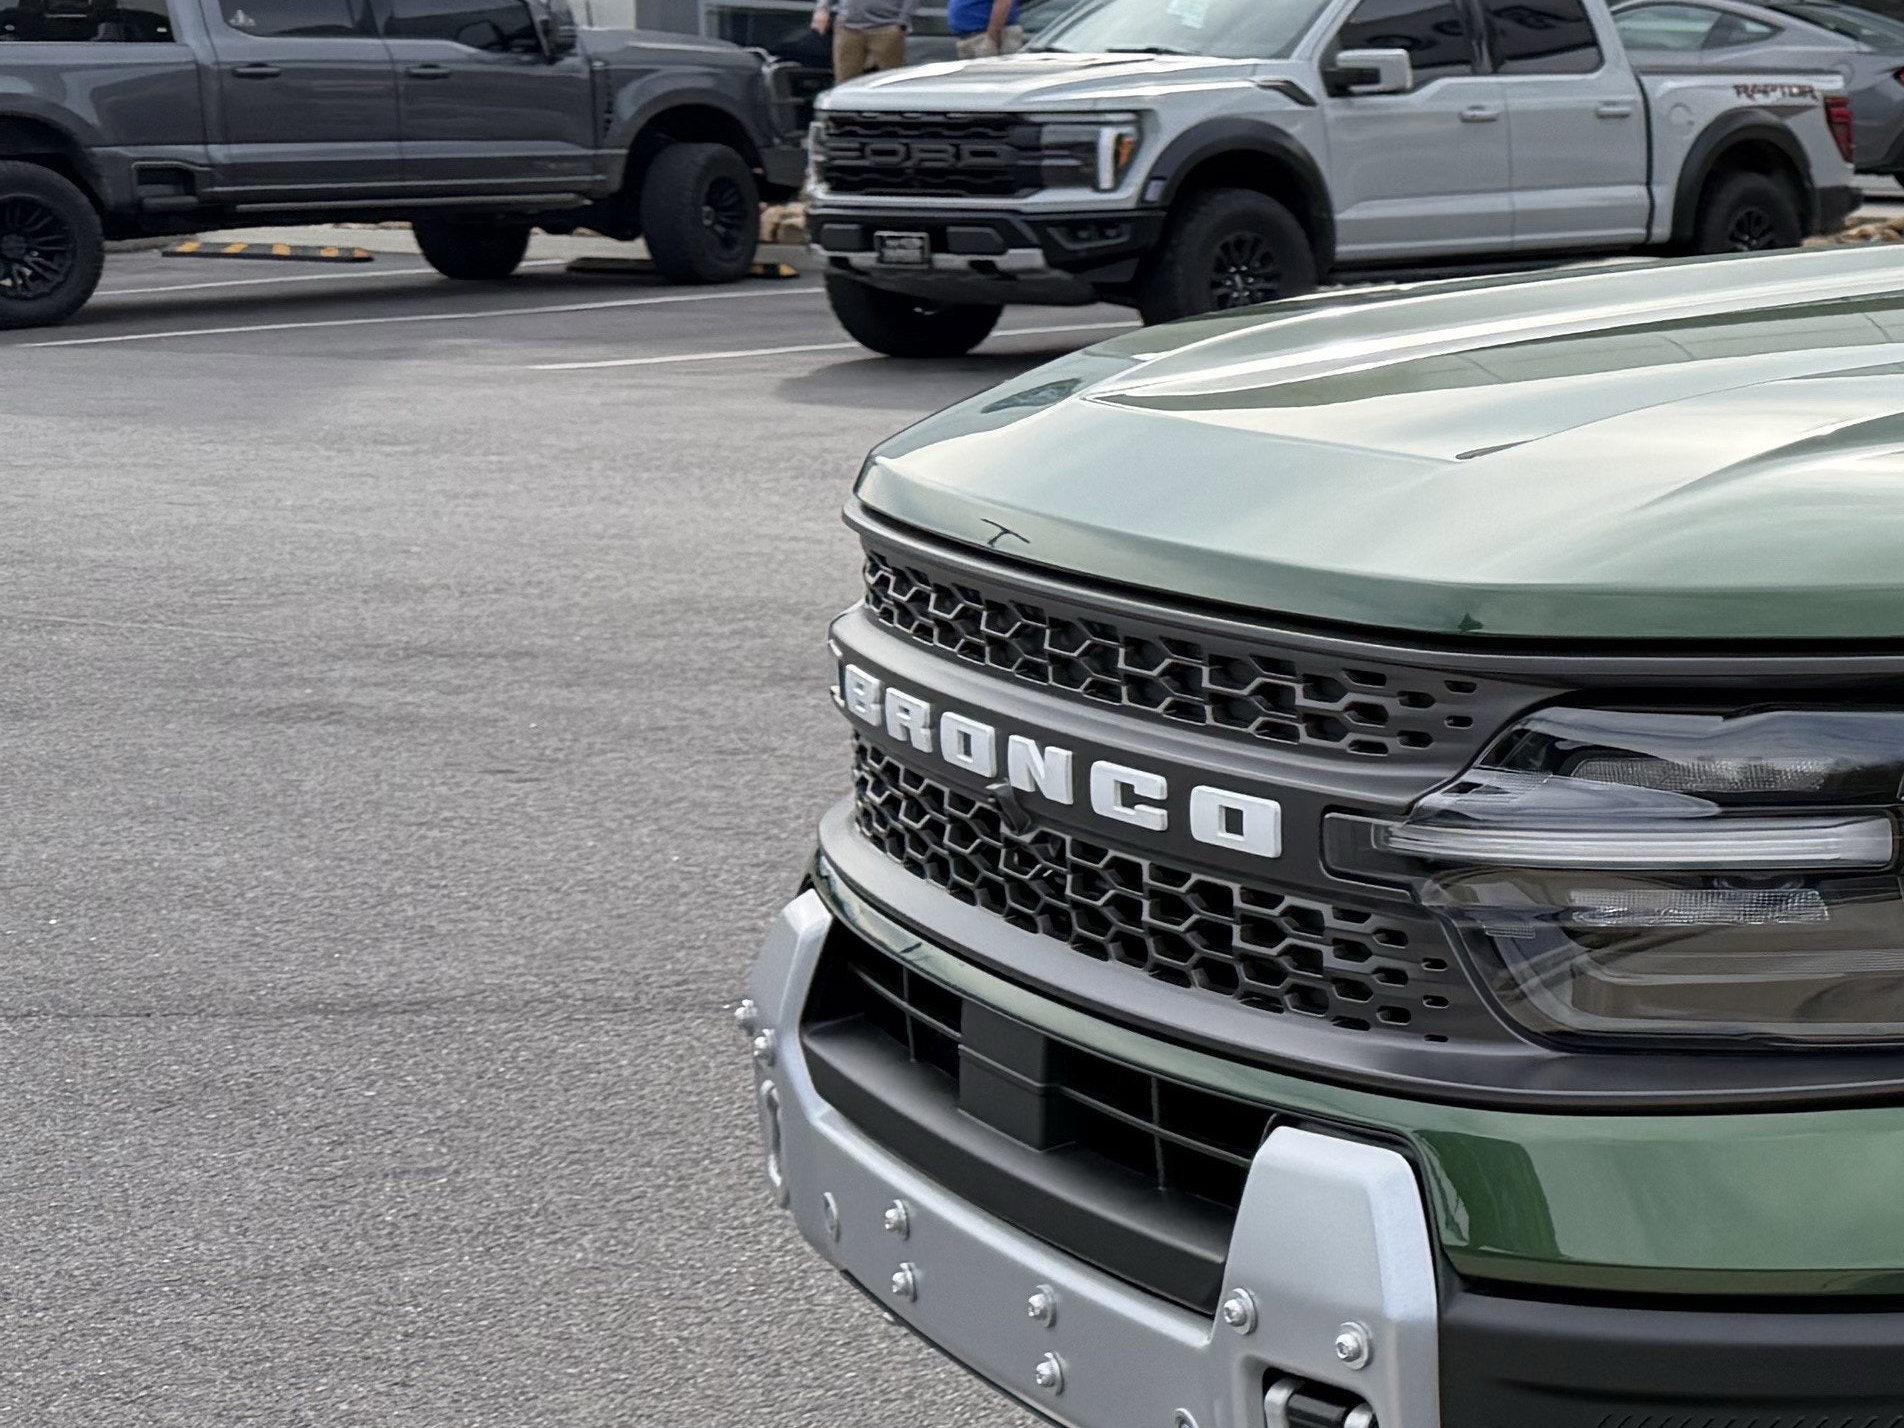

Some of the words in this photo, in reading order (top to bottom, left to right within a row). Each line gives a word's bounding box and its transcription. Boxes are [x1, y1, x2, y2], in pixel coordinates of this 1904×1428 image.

[1732, 83, 1818, 102] RAPTOR
[823, 142, 1013, 169] FORD
[844, 663, 1283, 859] BRONCO
